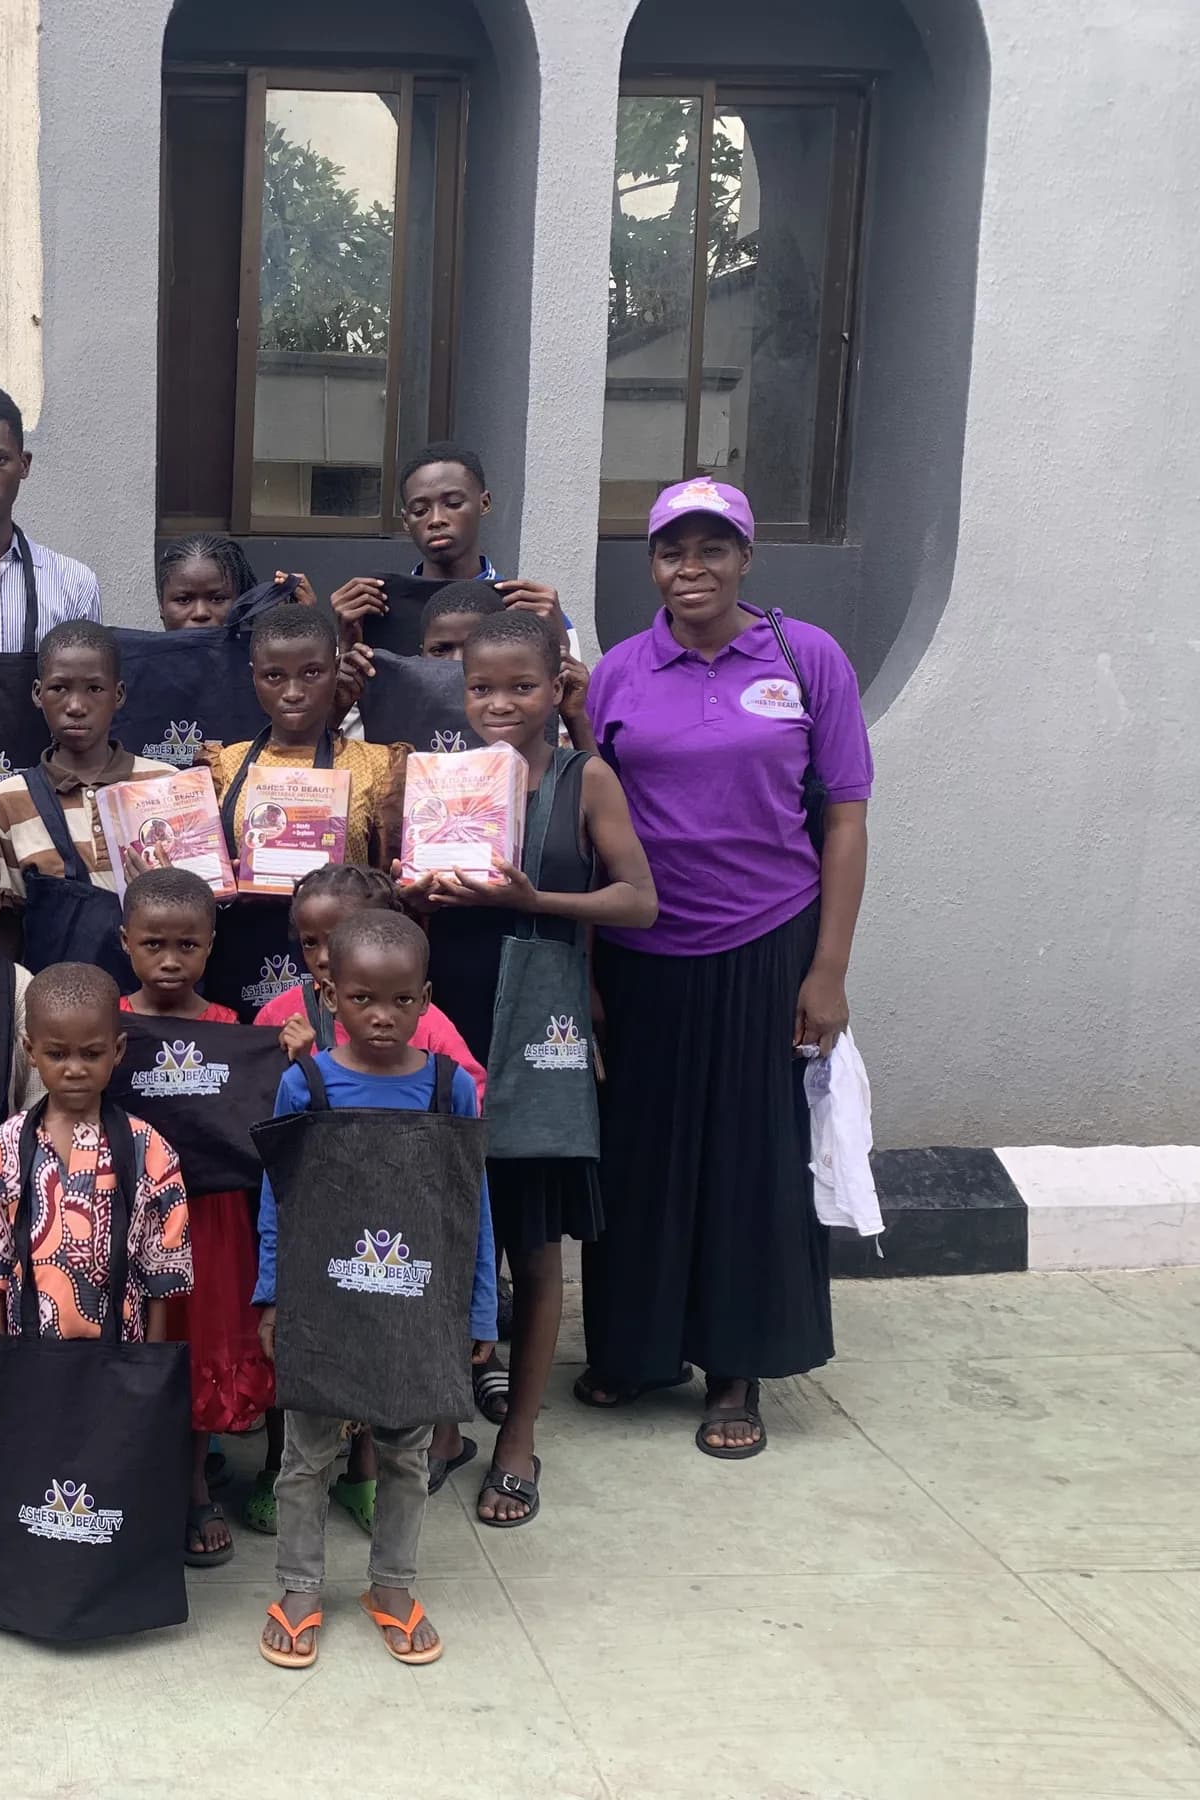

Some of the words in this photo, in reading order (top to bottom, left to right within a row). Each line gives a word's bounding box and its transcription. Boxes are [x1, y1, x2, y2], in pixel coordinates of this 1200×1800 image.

[142, 744, 172, 754] ASHES
[174, 791, 205, 801] BEAUTY
[301, 786, 335, 794] BEAUTY
[241, 984, 269, 998] ASHES
[524, 1044, 556, 1056] ASHES
[131, 1071, 166, 1084] ASHES
[167, 1070, 185, 1083] TO
[186, 1070, 230, 1083] BEAUTY
[328, 1258, 365, 1275] ASHES
[368, 1264, 386, 1278] TO
[388, 1267, 432, 1283] BEAUTY
[19, 1505, 54, 1523] ASHES
[56, 1513, 74, 1526] TO
[75, 1516, 123, 1530] BEAUTY
